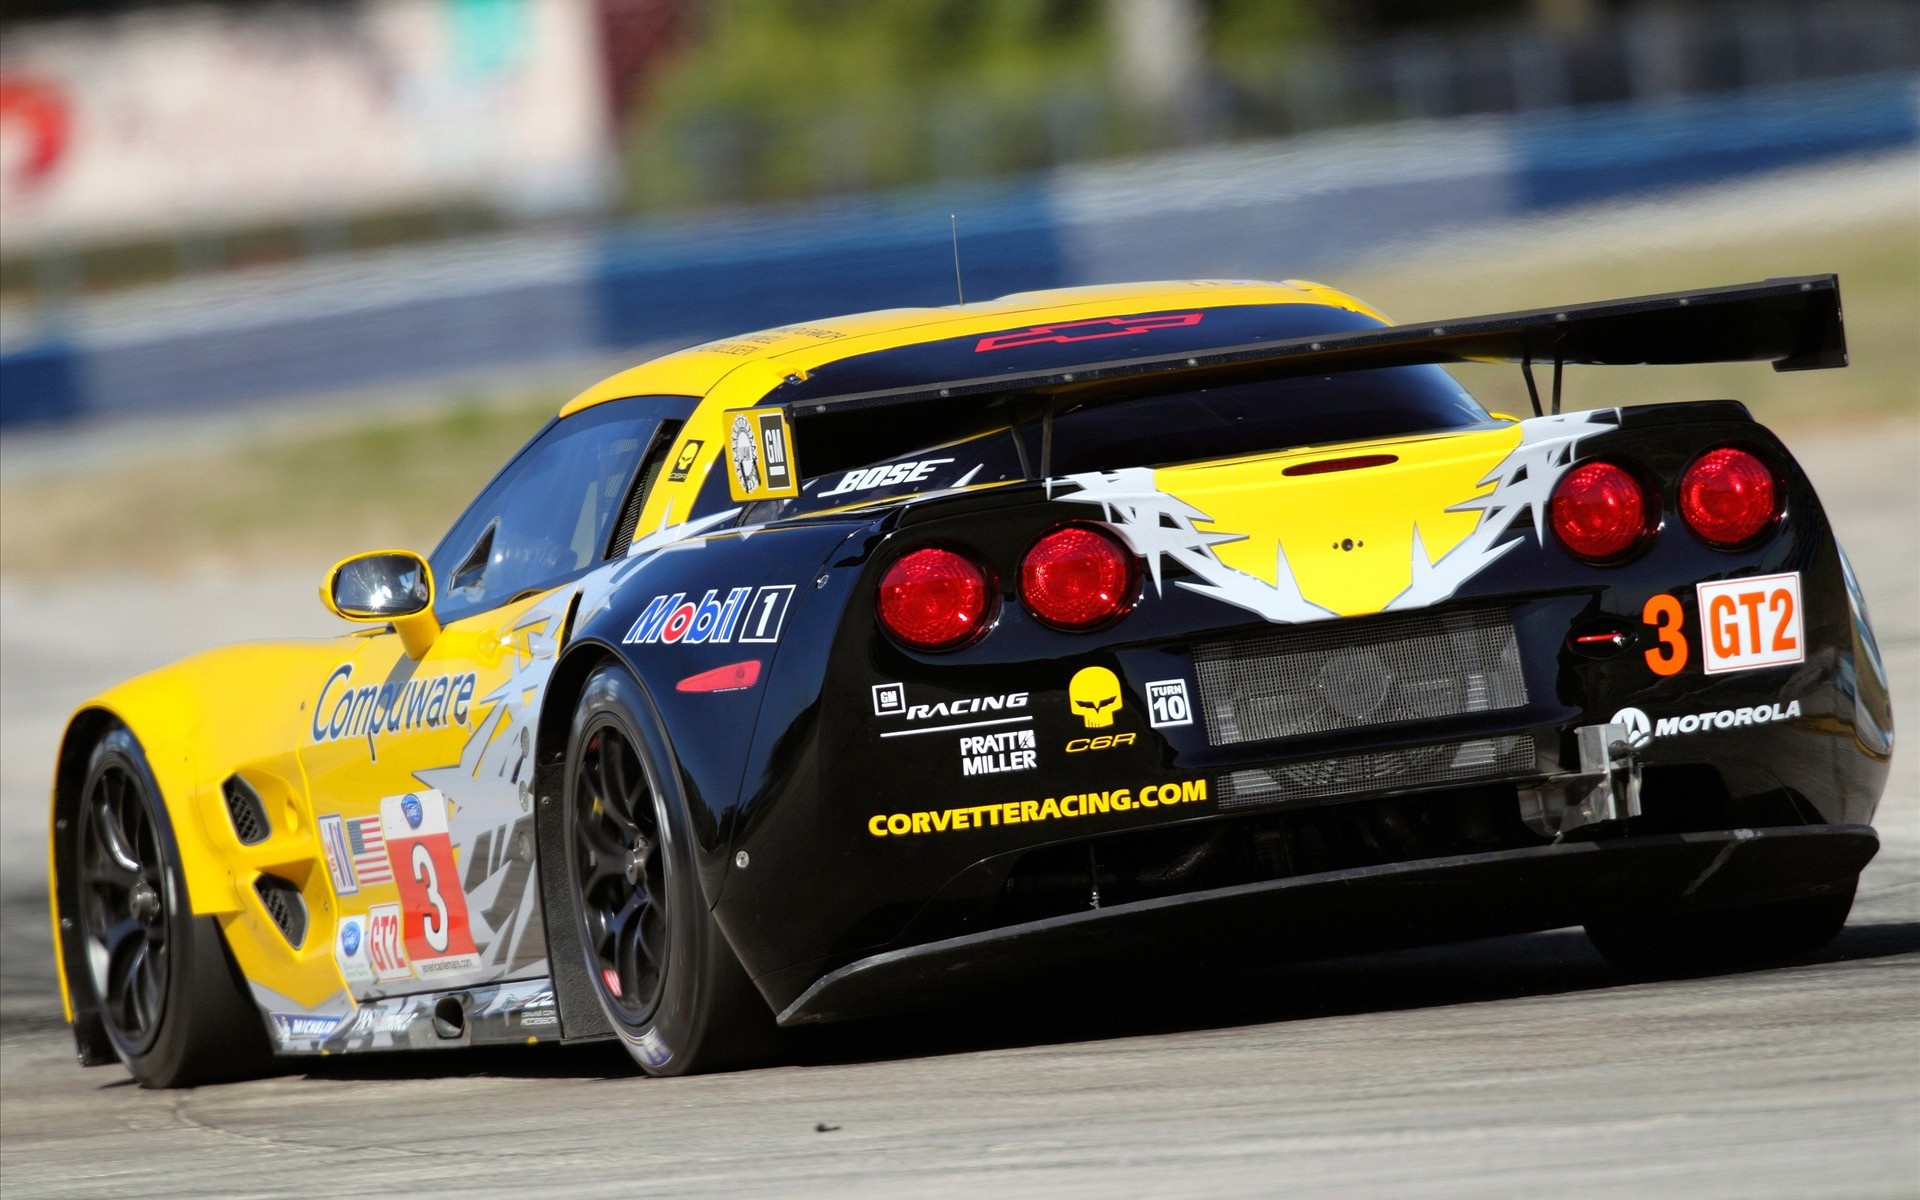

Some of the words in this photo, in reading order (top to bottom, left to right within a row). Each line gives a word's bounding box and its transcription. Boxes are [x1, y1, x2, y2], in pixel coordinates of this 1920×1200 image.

[764, 429, 785, 463] GM
[817, 458, 955, 498] BOSE
[622, 586, 753, 644] Mobil
[755, 592, 779, 637] 1
[1709, 588, 1797, 659] GT2
[1642, 594, 1689, 676] 3
[880, 690, 898, 704] GM
[906, 692, 1030, 720] RACING
[1151, 684, 1182, 697] TURN
[1153, 695, 1186, 722] 10
[312, 664, 477, 762] Compuware
[1654, 700, 1801, 738] MOTOROLA
[960, 731, 1018, 756] PRATT
[1065, 732, 1137, 753] C6R
[962, 750, 1038, 776] MILLER
[868, 779, 1207, 837] CORVETTERACING.COM
[412, 841, 449, 953] 3
[370, 914, 407, 972] GT2
[292, 1018, 338, 1035] MICHELIN
